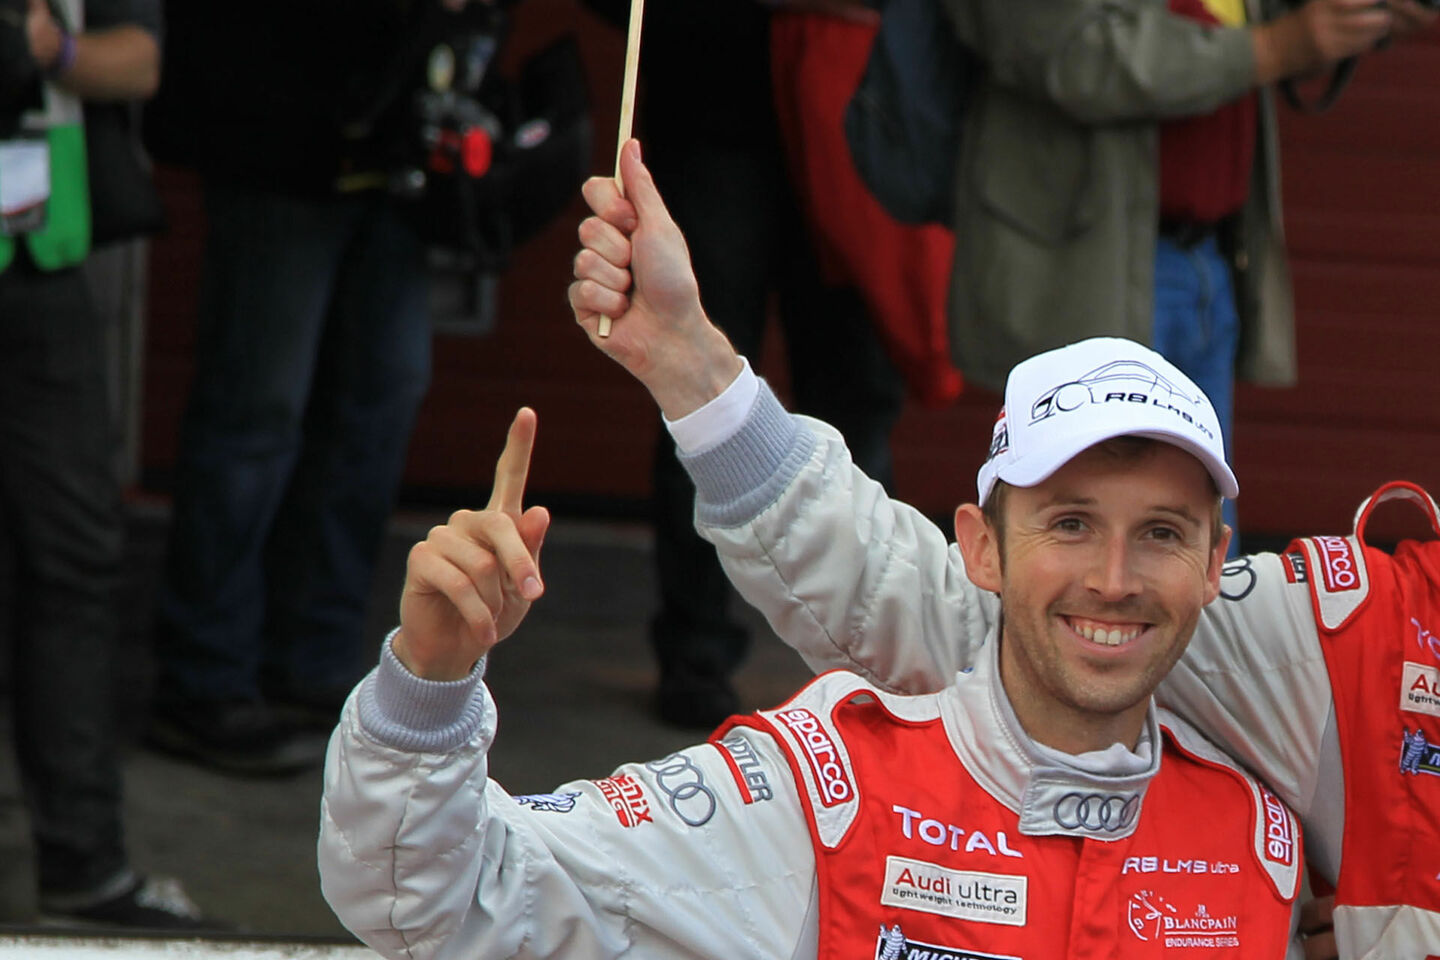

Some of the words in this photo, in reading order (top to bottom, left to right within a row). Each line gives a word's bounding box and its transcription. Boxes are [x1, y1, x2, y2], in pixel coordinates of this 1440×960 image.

[1104, 392, 1149, 404] R8
[1153, 398, 1194, 425] LMS
[1322, 536, 1356, 588] arco
[722, 737, 774, 802] DTLER
[780, 709, 849, 804] sparco
[892, 804, 1024, 858] TOTAL
[1264, 792, 1292, 862] spar
[1122, 856, 1158, 874] R8
[1163, 859, 1208, 873] LMS
[895, 868, 951, 894] Audi
[958, 881, 1017, 904] ultra
[955, 899, 1017, 915] technology
[1163, 916, 1237, 930] BLANCPAIN
[1164, 937, 1215, 948] ENDURANCE
